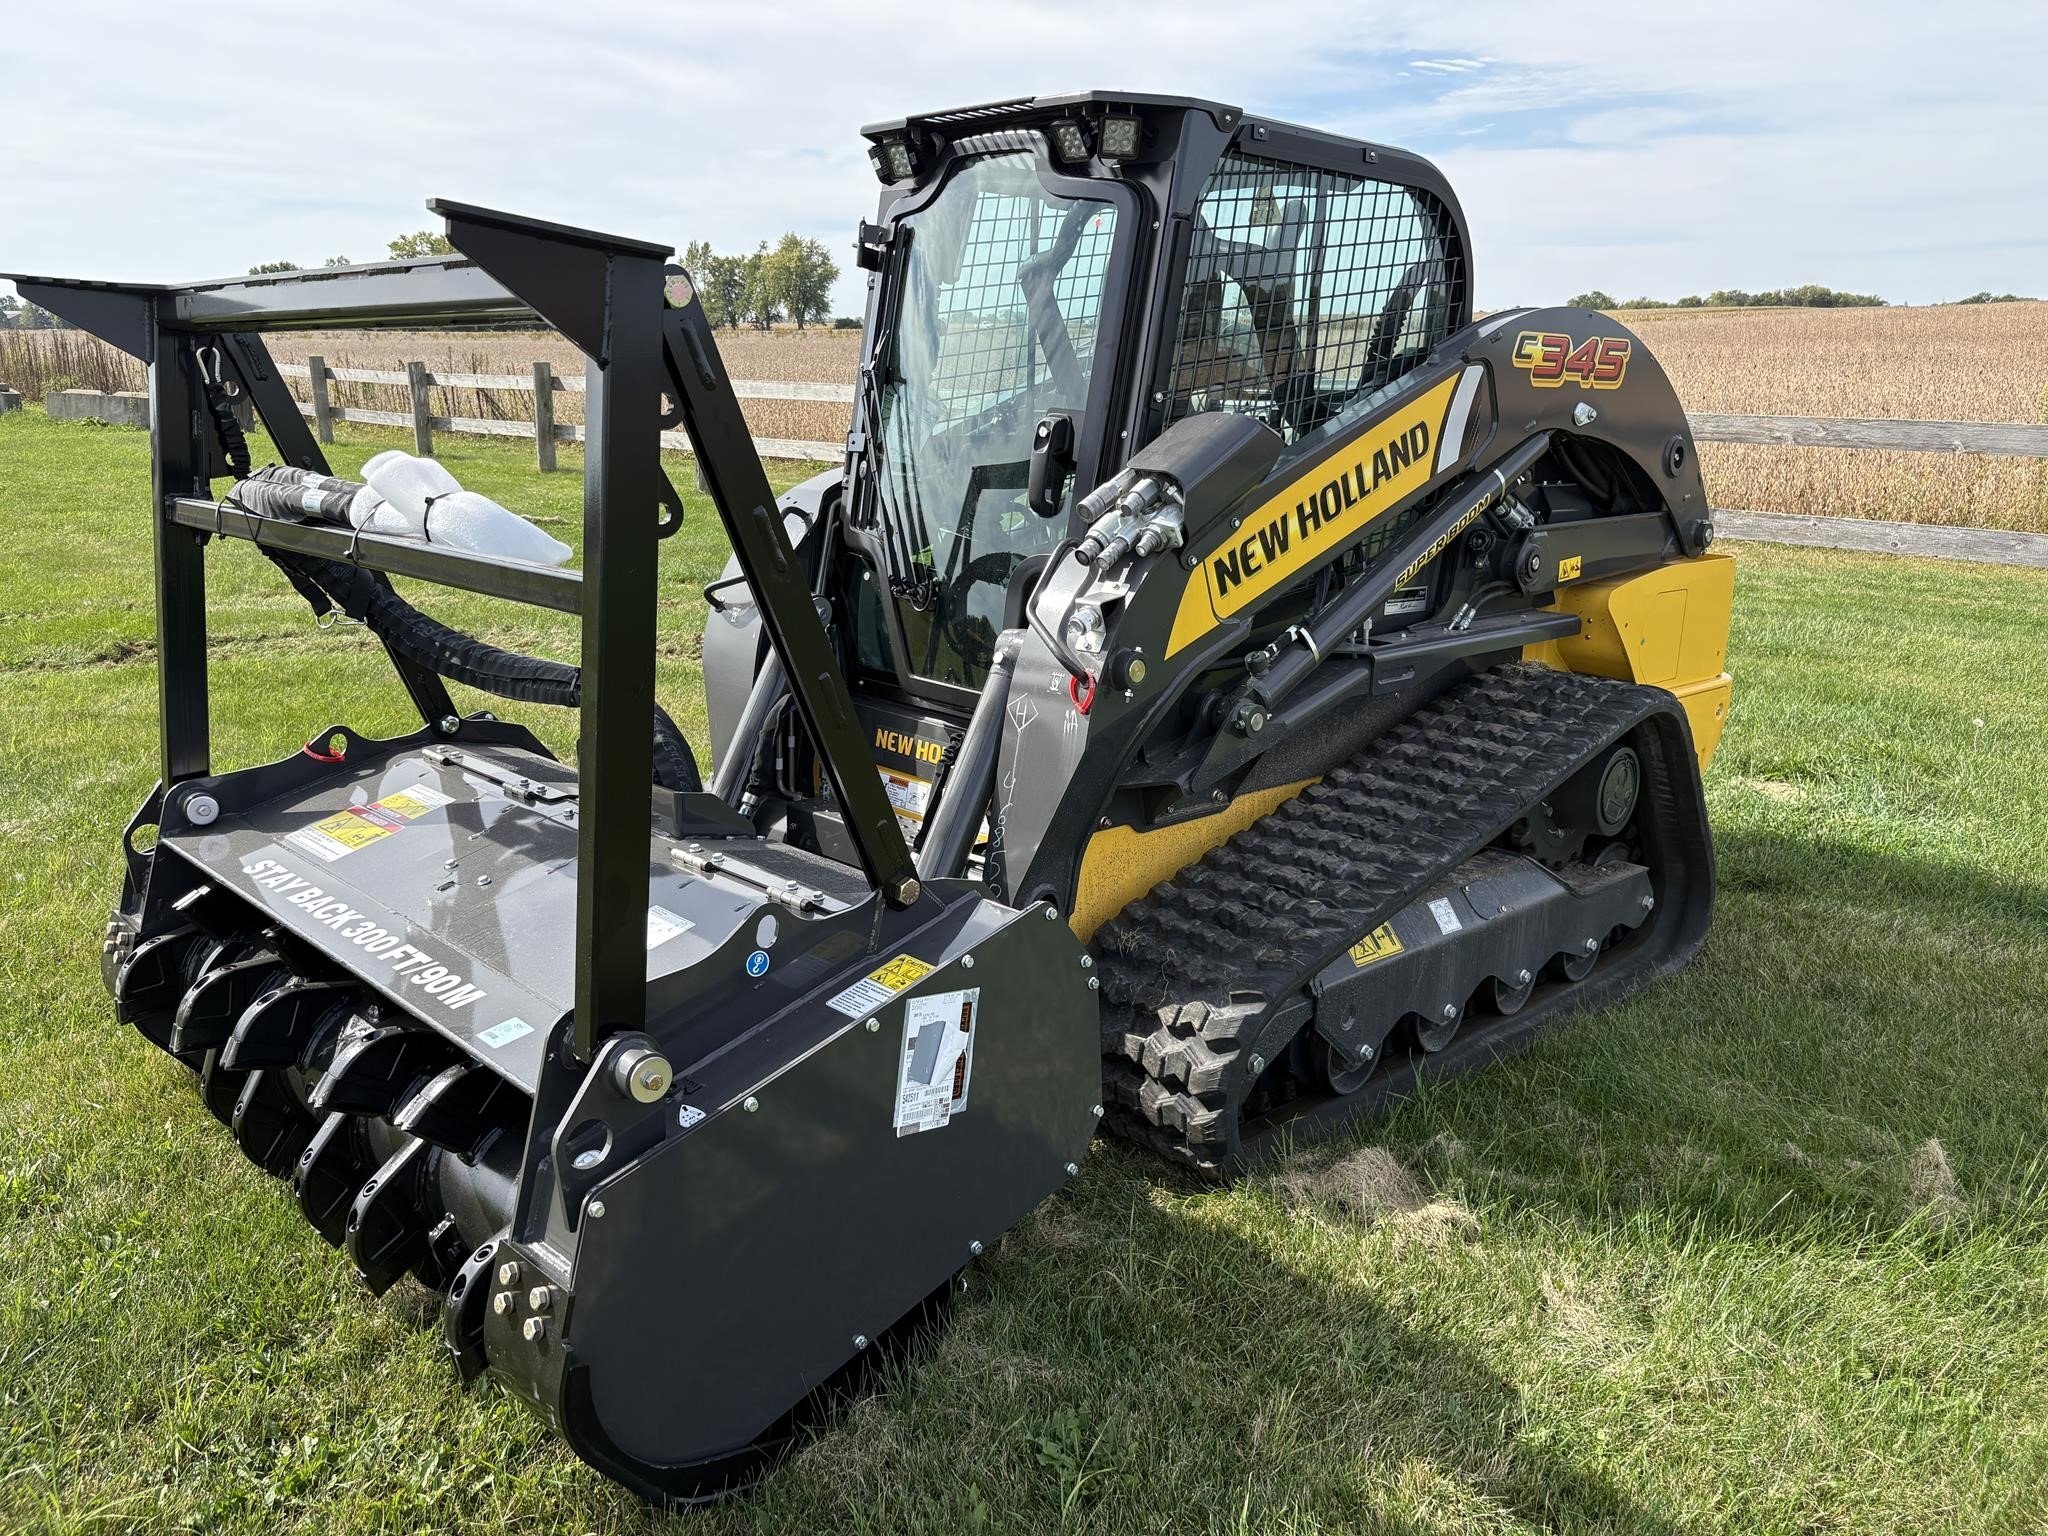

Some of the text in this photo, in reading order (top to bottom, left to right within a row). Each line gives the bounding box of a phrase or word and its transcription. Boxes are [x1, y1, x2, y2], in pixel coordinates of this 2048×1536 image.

[1512, 331, 1631, 389] C345
[1213, 420, 1430, 598] NEW HOLLAND
[1394, 493, 1490, 592] SUPER BOOM
[875, 728, 914, 756] NEW
[242, 860, 488, 1010] STAY BACK 300 FT/90M
[906, 959, 931, 973] CAUTION
